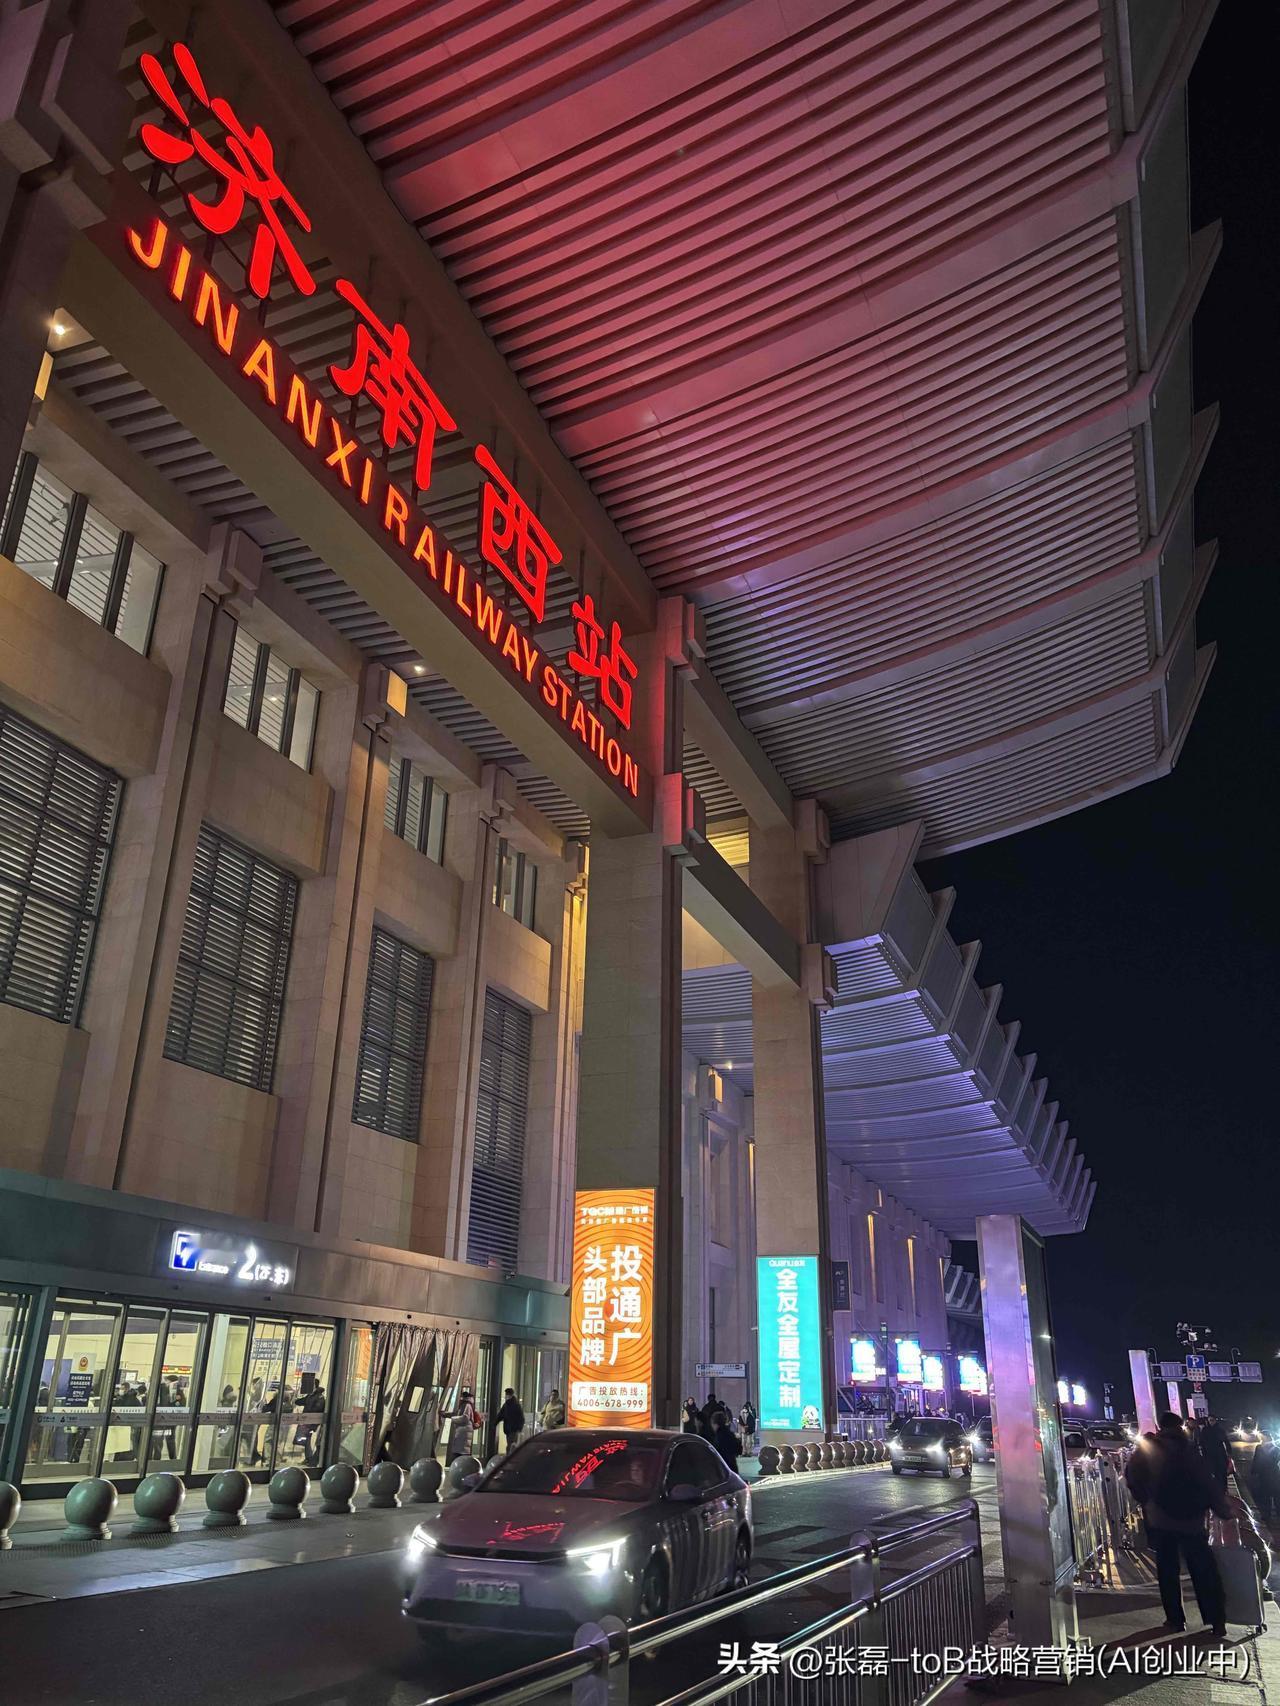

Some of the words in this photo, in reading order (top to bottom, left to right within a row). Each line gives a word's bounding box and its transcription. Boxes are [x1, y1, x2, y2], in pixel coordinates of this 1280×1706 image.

[139, 43, 638, 730] 济南西站
[129, 219, 373, 505] JINANXI
[384, 495, 539, 684] RAILWAY
[541, 667, 639, 798] STATION
[580, 1246, 607, 1367] 头部品牌
[609, 1245, 643, 1366] 投通广
[1191, 1358, 1200, 1368] P
[577, 1398, 644, 1409] 4006-678-999
